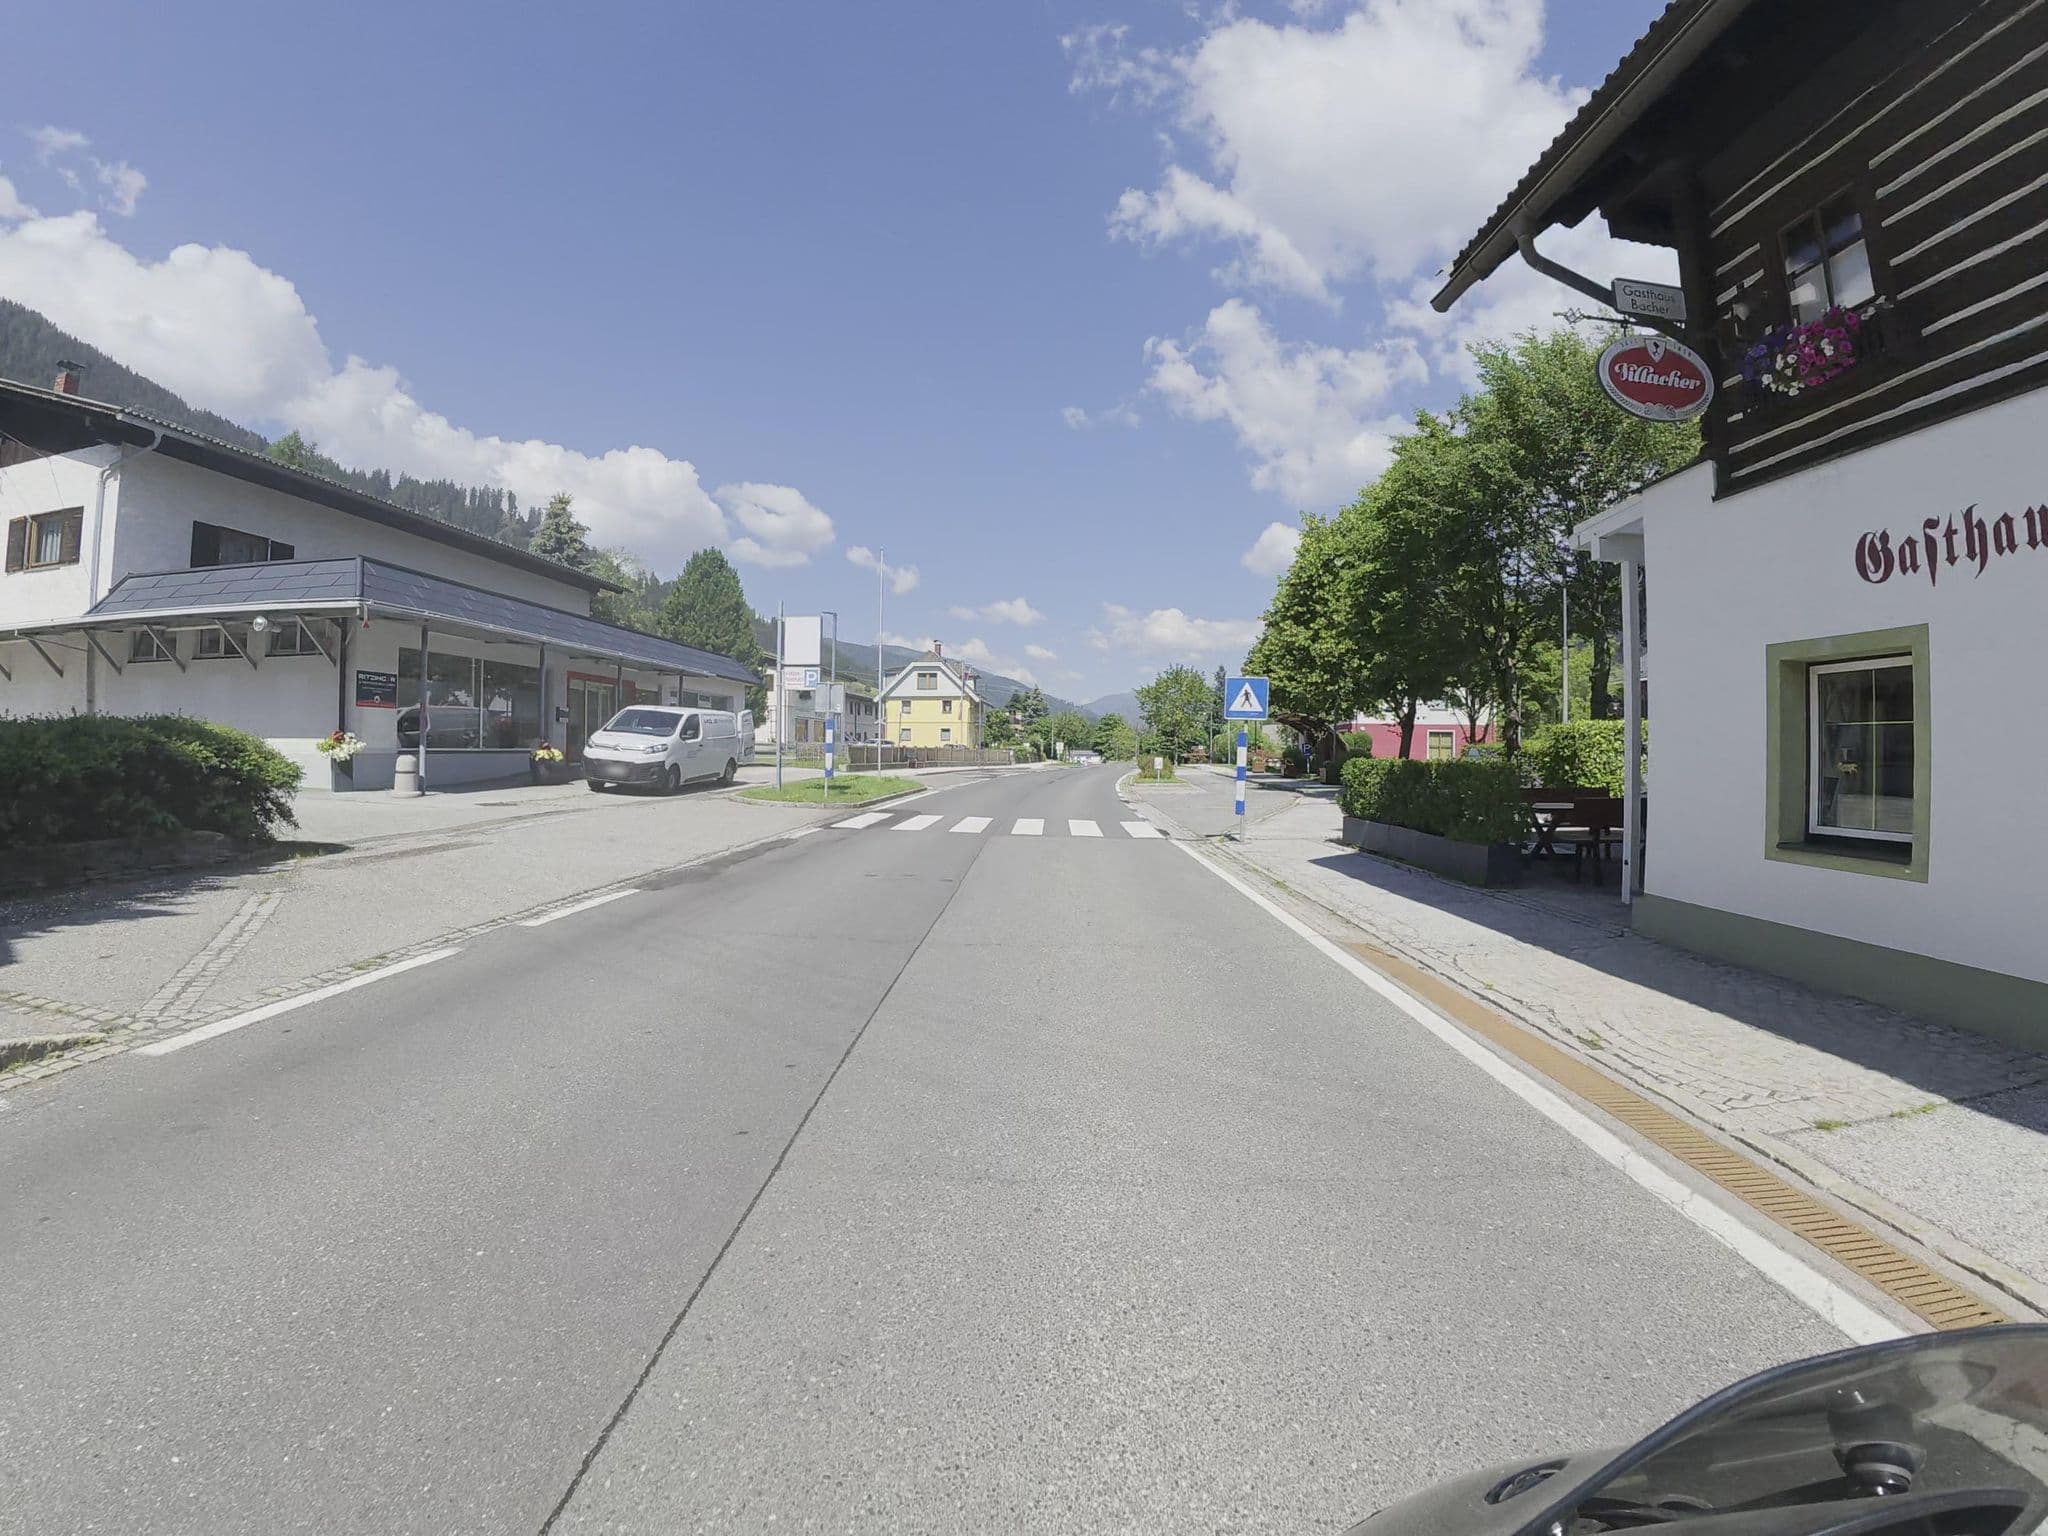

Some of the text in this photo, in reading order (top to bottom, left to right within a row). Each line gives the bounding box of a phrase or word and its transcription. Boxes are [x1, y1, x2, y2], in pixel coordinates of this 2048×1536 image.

[1623, 285, 1675, 303] Gasthaus
[1631, 298, 1669, 314] Bacher
[1614, 362, 1702, 390] Villacher
[806, 671, 818, 686] P
